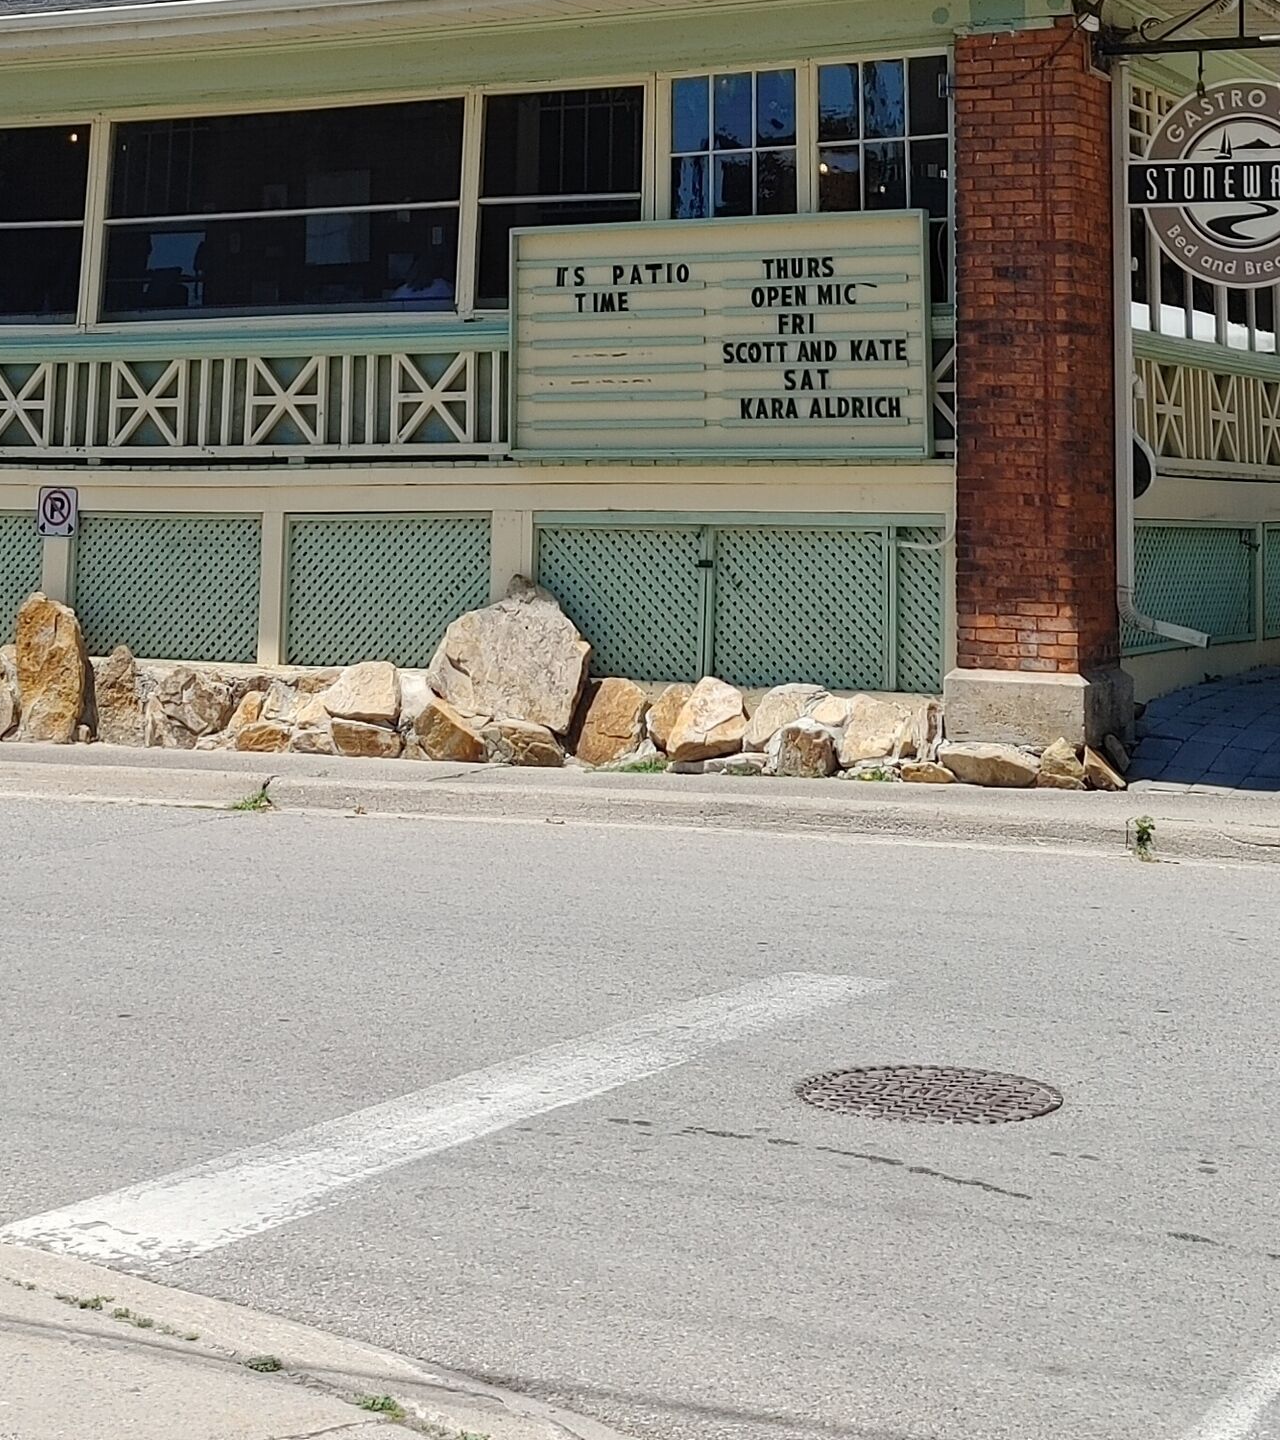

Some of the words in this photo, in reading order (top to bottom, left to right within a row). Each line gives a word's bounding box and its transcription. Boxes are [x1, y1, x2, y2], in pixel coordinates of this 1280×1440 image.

[1166, 89, 1267, 143] GASTRO
[1167, 224, 1199, 258] Bed
[1200, 254, 1237, 275] and
[612, 263, 690, 286] PATIO
[762, 257, 835, 280] THURS
[575, 292, 629, 313] TIME
[751, 285, 807, 308] OPEN
[819, 284, 857, 306] MIC
[778, 313, 815, 335] FRI
[723, 341, 789, 364] SCOTT
[797, 340, 837, 362] AND
[850, 338, 907, 361] KATE
[784, 369, 830, 391] SAT
[740, 398, 799, 420] KARA
[809, 396, 901, 419] ALDRICH
